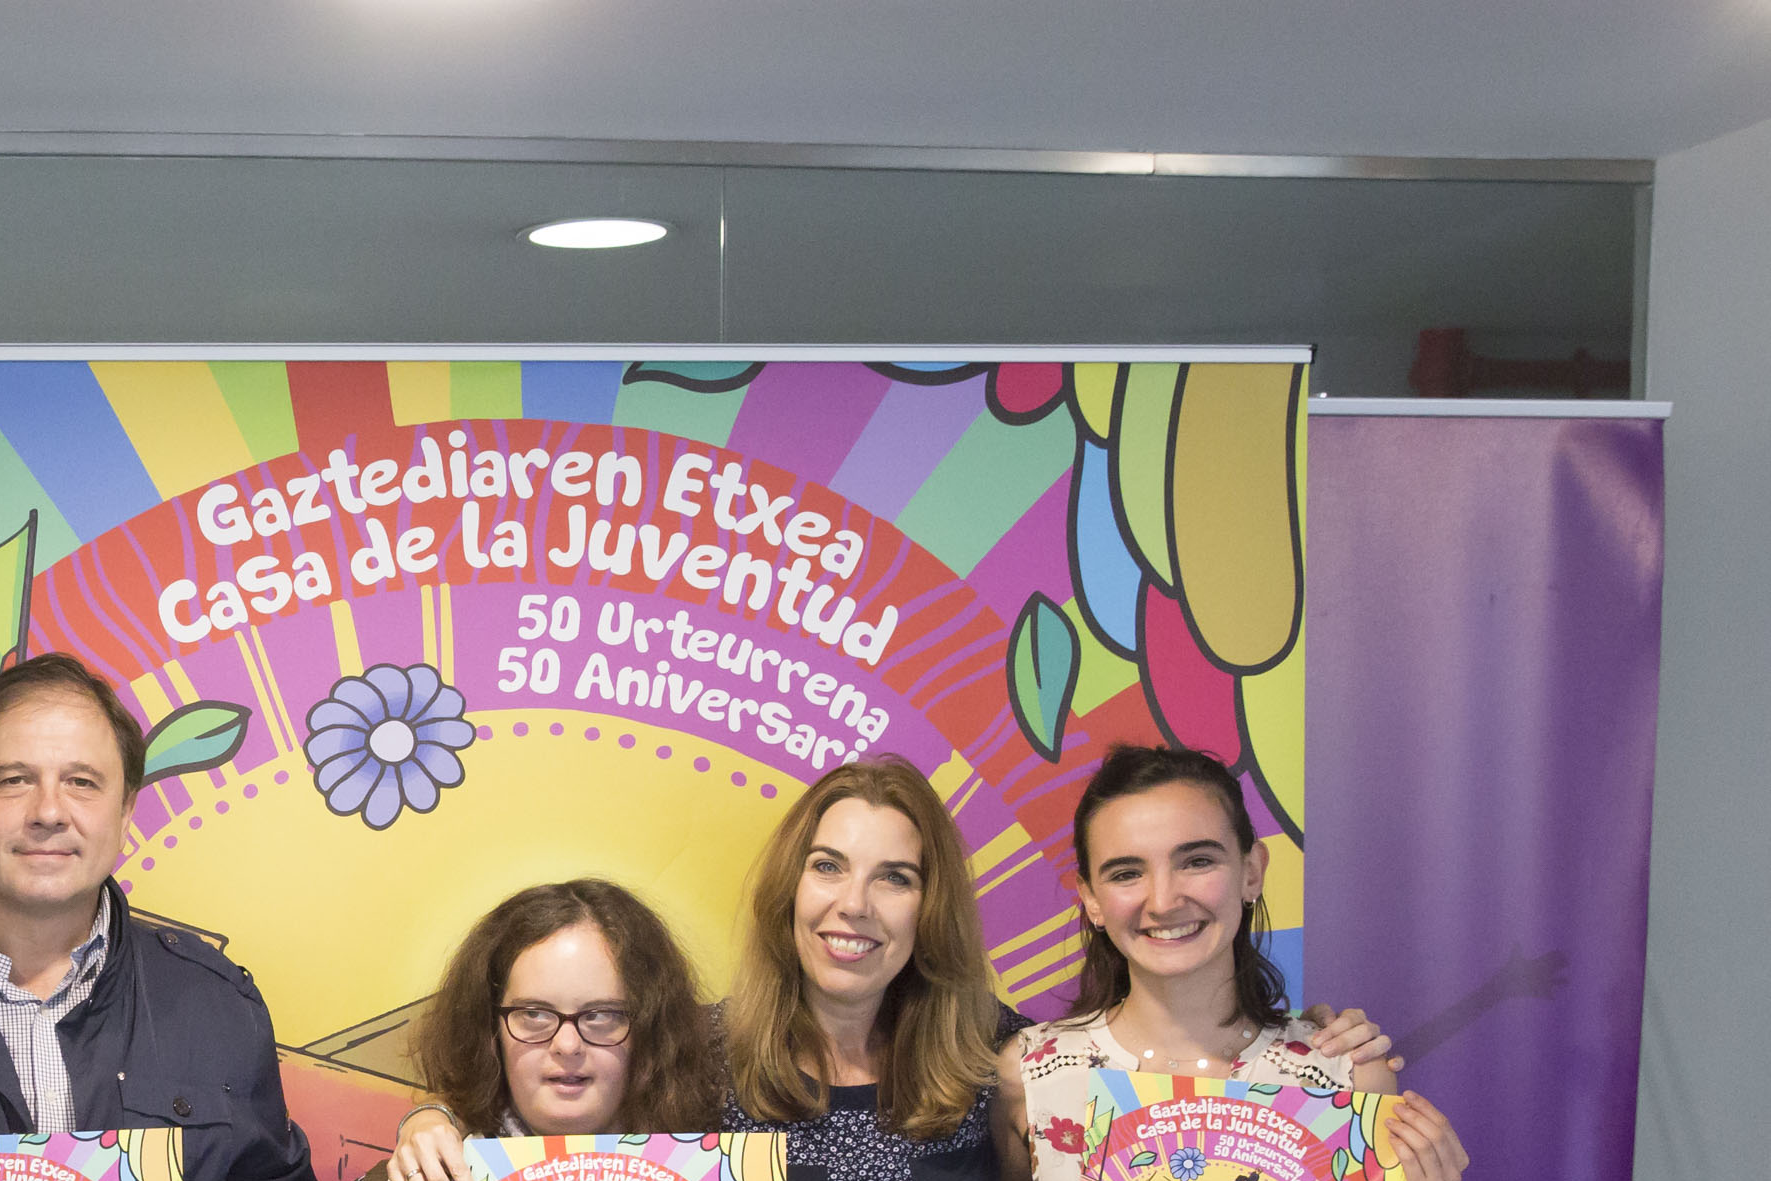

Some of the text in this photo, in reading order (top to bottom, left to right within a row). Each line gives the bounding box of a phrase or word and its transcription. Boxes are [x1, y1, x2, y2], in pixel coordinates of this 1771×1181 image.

[197, 430, 863, 579] Gaztediaren Etxea
[158, 501, 898, 665] Casa de la Juventud
[498, 647, 560, 694] 50
[518, 594, 889, 743] 50 Urteurrena
[1134, 1112, 1308, 1160] Casa de la Juventud
[1145, 1096, 1303, 1141] Gaztediaren Etxea
[523, 1153, 624, 1181] Gaztediaren
[1213, 1144, 1231, 1157] 50
[1217, 1133, 1305, 1177] 50 Urteurrena
